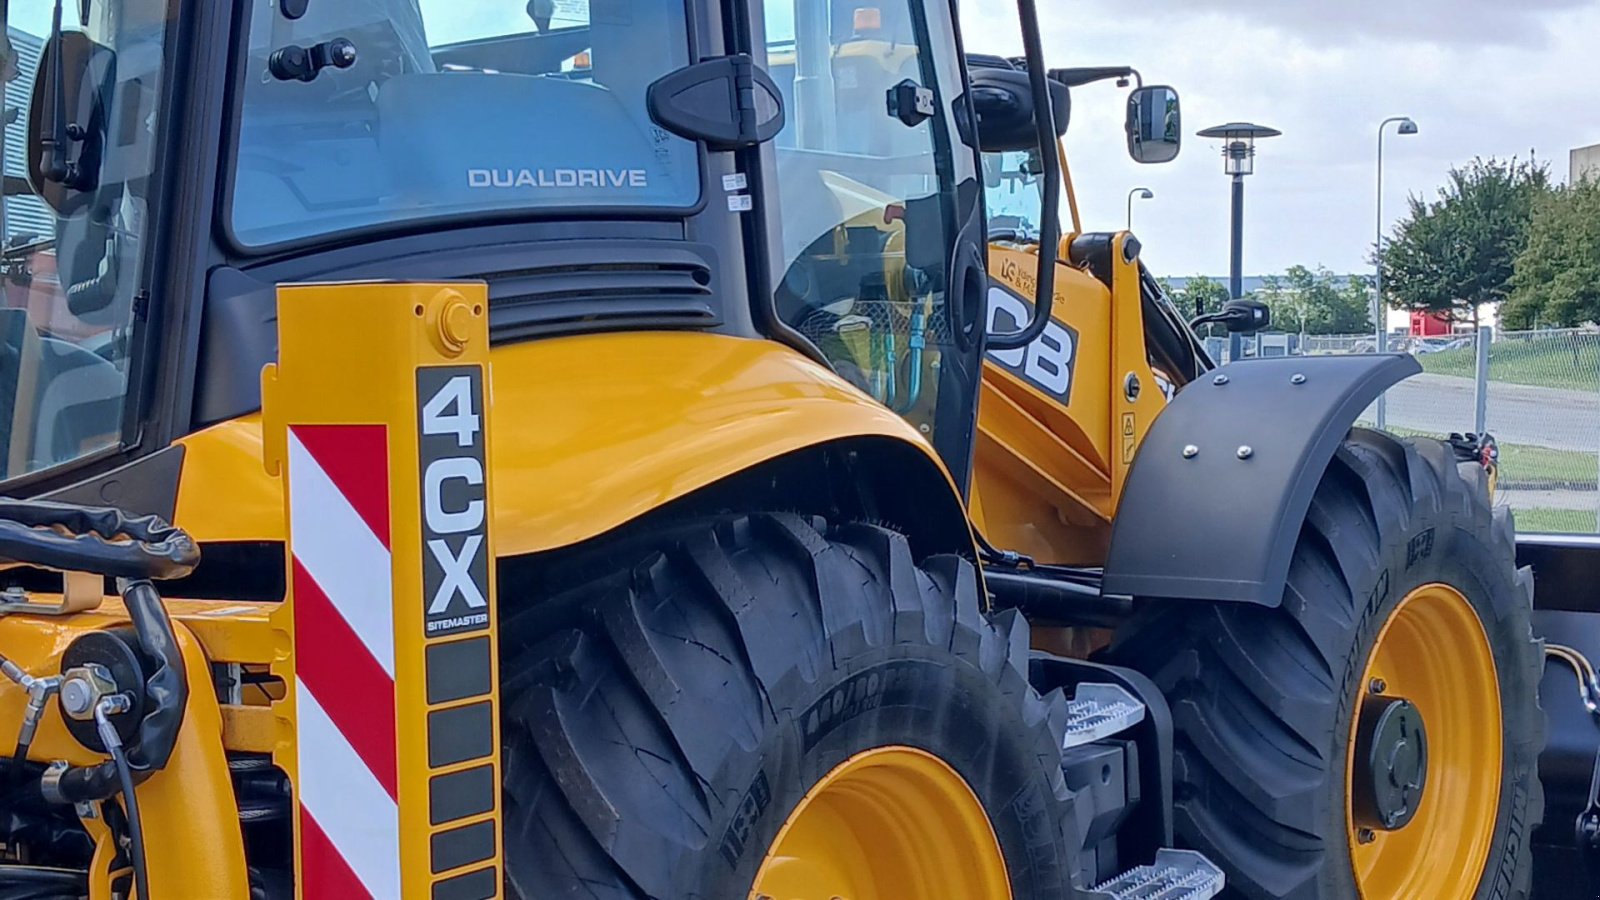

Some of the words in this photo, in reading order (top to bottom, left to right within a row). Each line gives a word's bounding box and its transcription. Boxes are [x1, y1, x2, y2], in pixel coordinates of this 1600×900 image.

[467, 168, 648, 188] DUALDRIVE
[984, 286, 1074, 396] CB
[422, 375, 487, 614] 4CX
[427, 613, 488, 632] SITEMASTER
